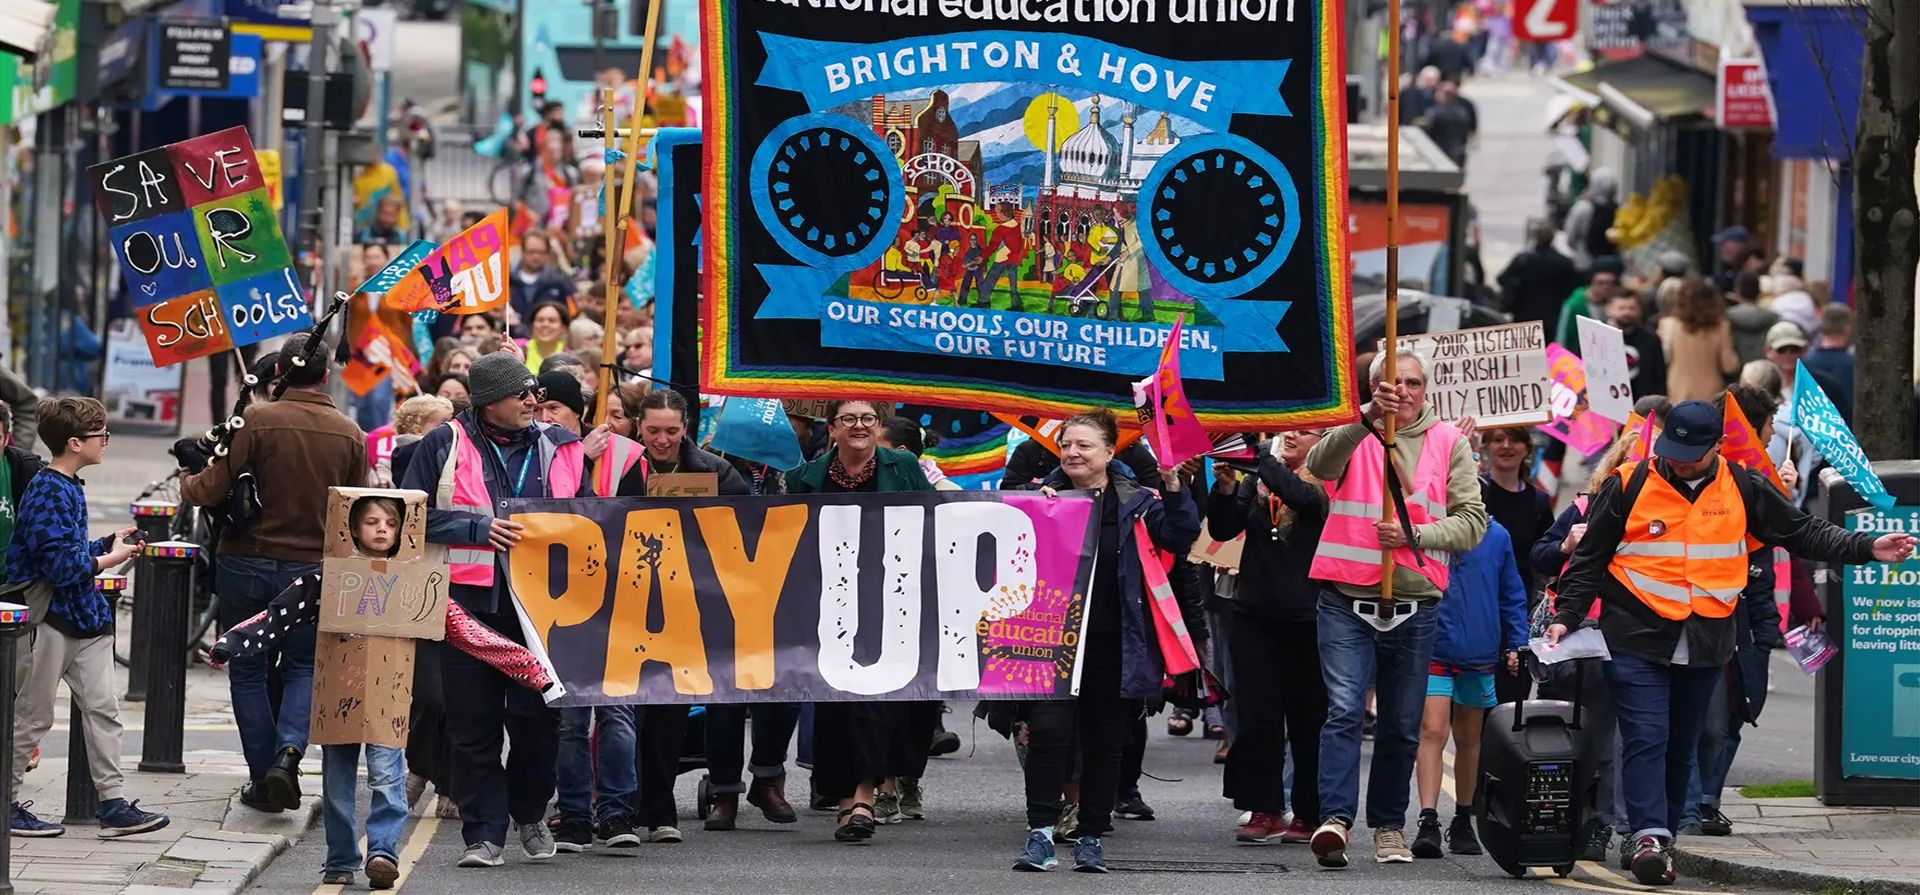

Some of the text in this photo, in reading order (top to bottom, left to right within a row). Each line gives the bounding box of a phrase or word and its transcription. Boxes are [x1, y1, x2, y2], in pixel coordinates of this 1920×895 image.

[1168, 0, 1294, 24] union
[824, 40, 1216, 112] BRIGHTON & HOVE
[102, 146, 249, 221] SAVE
[904, 155, 972, 188] SCHOOL
[124, 208, 256, 273] OUR
[149, 267, 308, 347] SCHOOLS!
[827, 301, 880, 325] OUR
[888, 307, 1009, 338] SCHOOLS,
[1015, 317, 1068, 341] OUR
[935, 332, 1106, 366] OUR FUTURE
[1431, 333, 1469, 358] YOUR
[1473, 325, 1541, 354] LISTENING
[1434, 354, 1520, 385] ON, RISHI!
[1425, 389, 1469, 421] ULLY
[1828, 439, 1859, 477] union
[1854, 511, 1905, 533] Bin
[1853, 563, 1920, 586] it ho
[337, 571, 398, 616] PAY
[509, 501, 1038, 696] PAY UP
[1852, 596, 1873, 607] We
[1876, 599, 1904, 607] now
[1008, 608, 1067, 624] national
[1852, 612, 1869, 621] on
[1872, 611, 1892, 621] the
[1852, 624, 1871, 635] for
[1012, 644, 1053, 659] union
[1852, 639, 1897, 652] leaving
[1850, 752, 1877, 763] Love
[1879, 754, 1900, 763] our
